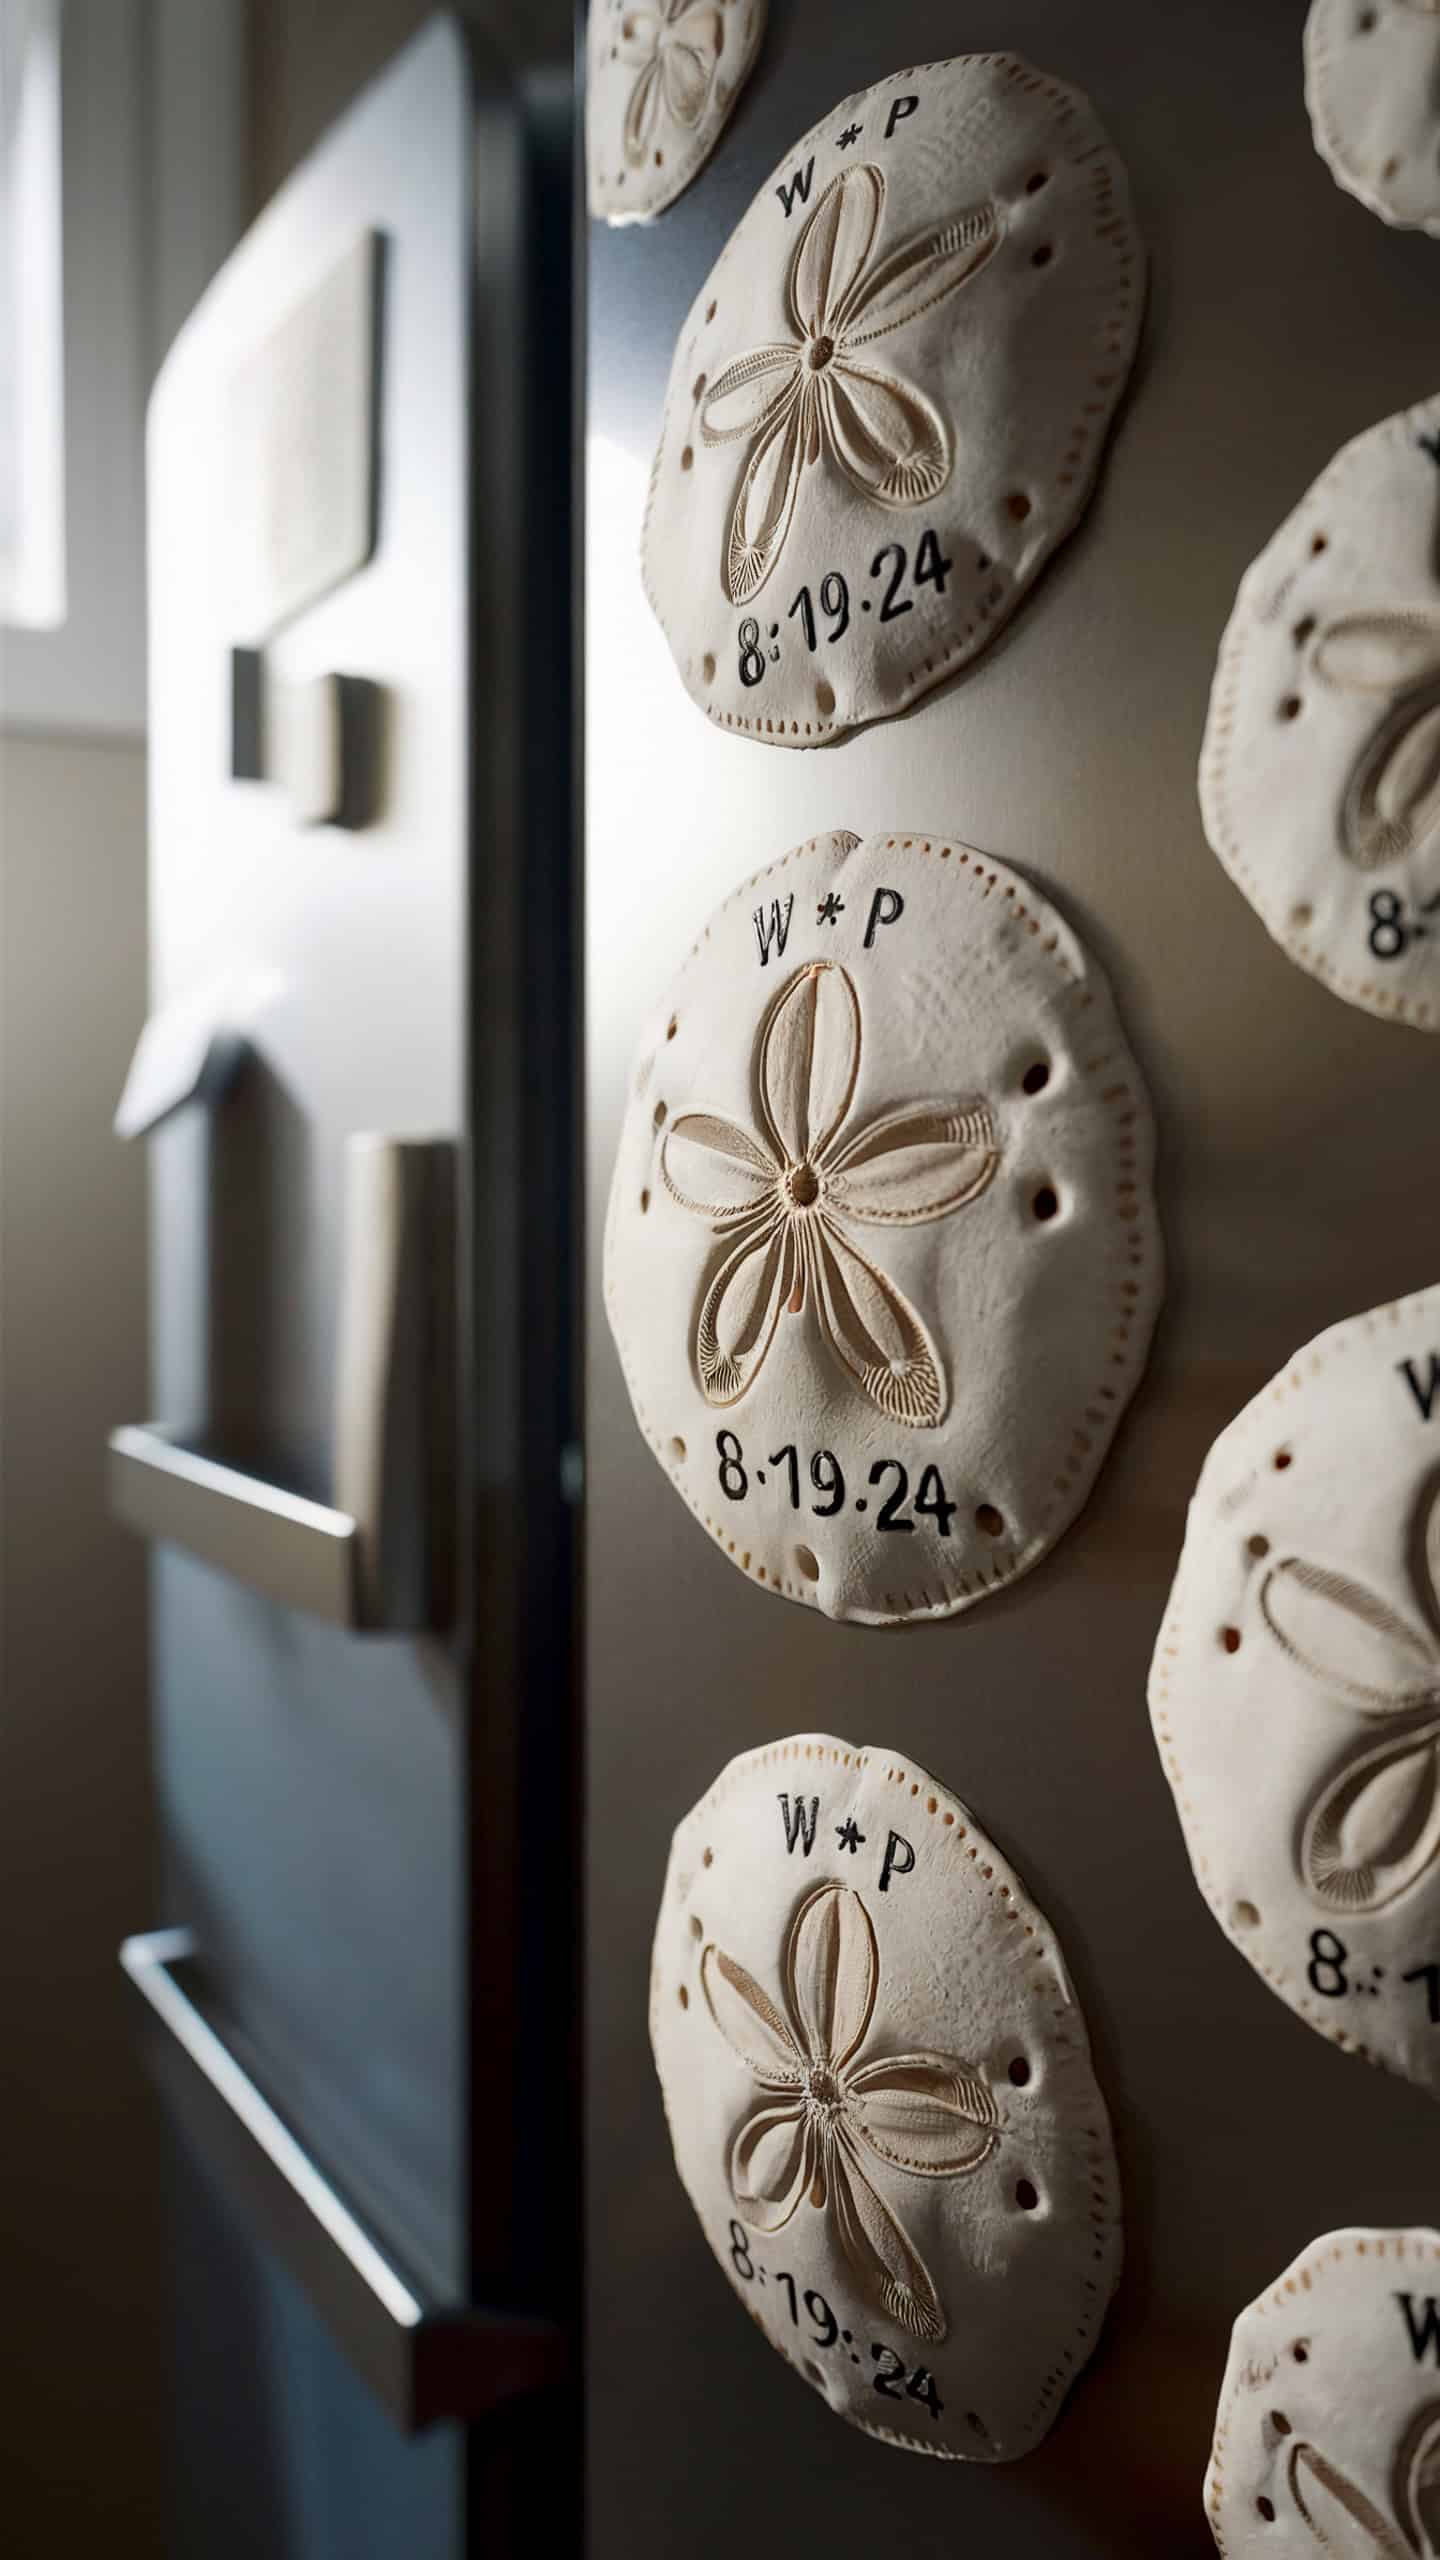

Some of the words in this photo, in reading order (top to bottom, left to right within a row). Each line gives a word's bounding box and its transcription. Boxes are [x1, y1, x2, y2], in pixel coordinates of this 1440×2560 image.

[776, 156, 815, 218] W
[884, 96, 920, 139] P
[753, 892, 795, 966] W
[863, 888, 904, 949] P
[777, 1793, 820, 1857] W
[878, 1830, 916, 1892] P
